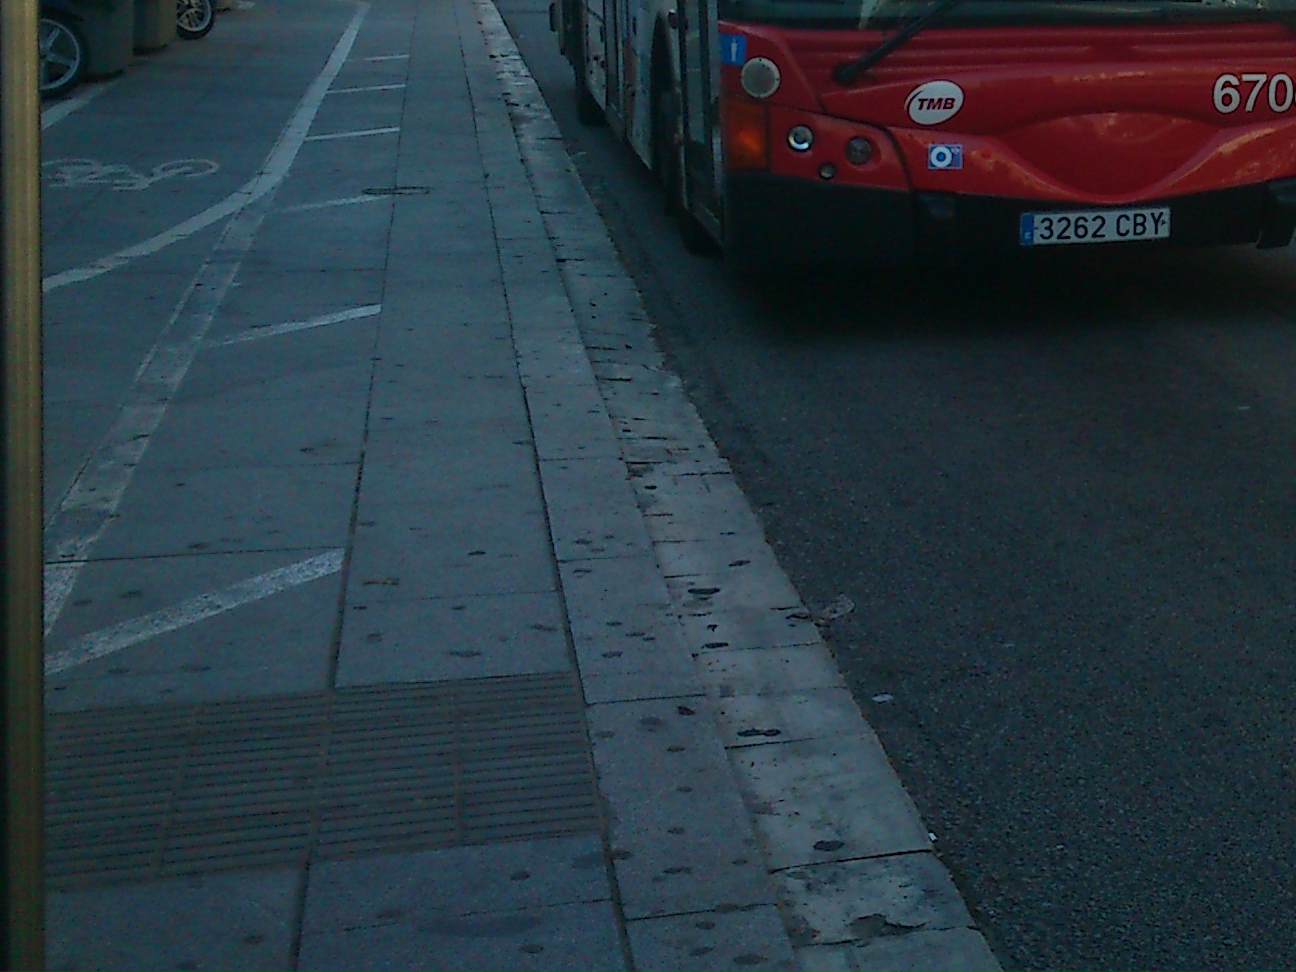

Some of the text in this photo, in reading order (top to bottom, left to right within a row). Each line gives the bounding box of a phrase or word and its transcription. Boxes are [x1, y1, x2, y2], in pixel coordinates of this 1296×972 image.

[917, 97, 956, 110] TMB
[1039, 211, 1164, 240] 3262 CBY
